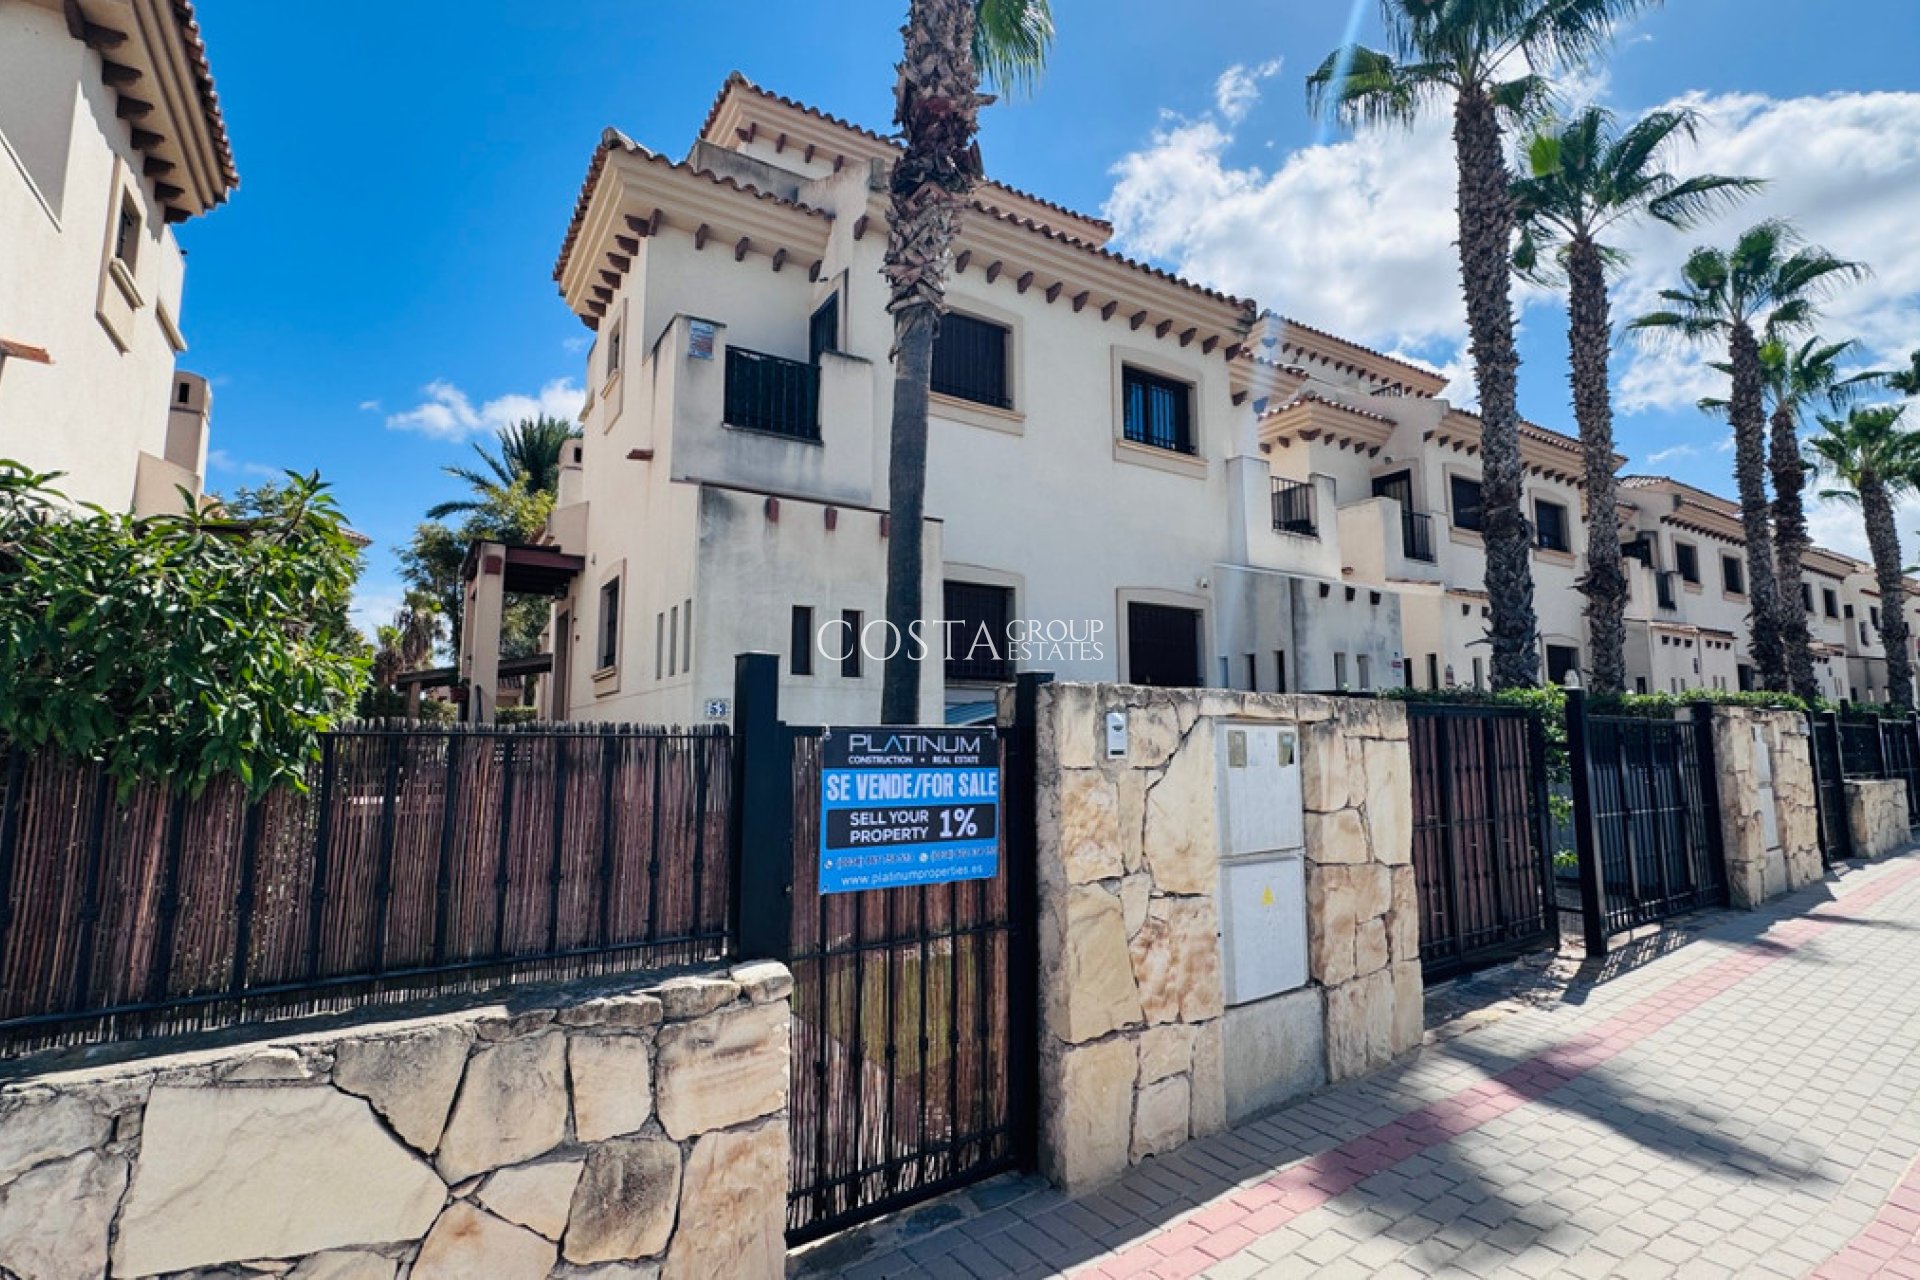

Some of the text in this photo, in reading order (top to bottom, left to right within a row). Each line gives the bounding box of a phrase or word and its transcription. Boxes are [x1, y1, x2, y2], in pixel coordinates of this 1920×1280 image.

[848, 734, 980, 753] PLATINUM
[848, 755, 979, 765] CONSTRUCTION REAL ESTATE
[827, 772, 998, 801] SE VENDE/FOR SALE
[850, 809, 929, 826] SELL YOUR
[939, 807, 978, 838] 1%
[849, 826, 929, 843] PROPERTY
